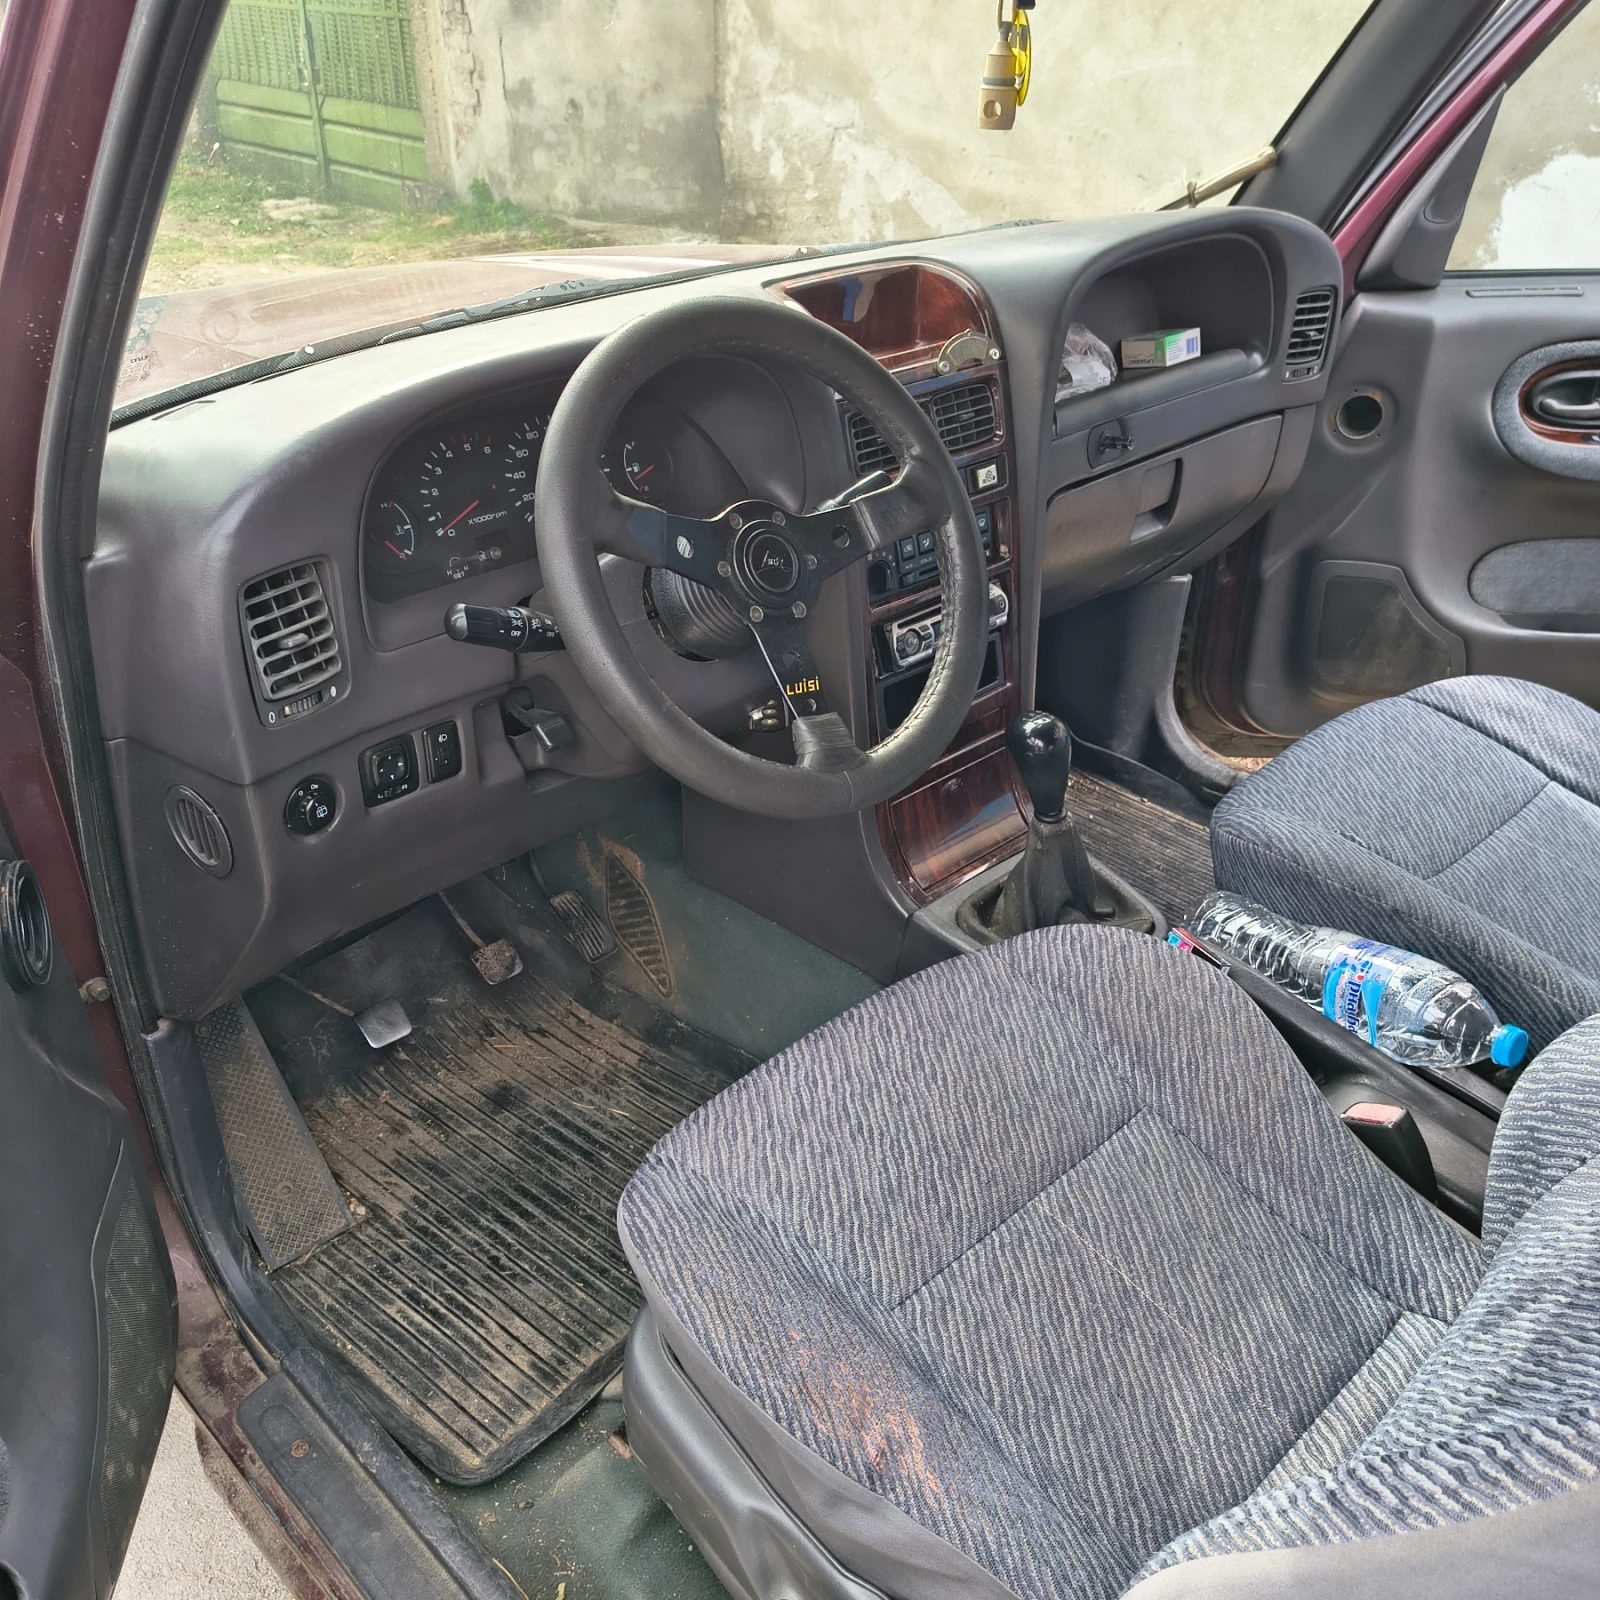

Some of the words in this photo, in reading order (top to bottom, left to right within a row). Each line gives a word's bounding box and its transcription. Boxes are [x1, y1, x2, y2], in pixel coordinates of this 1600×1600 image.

[525, 431, 539, 440] 80
[463, 443, 472, 451] 5
[483, 446, 491, 454] 6
[445, 450, 453, 458] 4
[515, 449, 529, 458] 60
[434, 467, 442, 475] 3
[513, 471, 526, 479] 40
[431, 488, 439, 496] 2
[522, 492, 535, 502] 20
[437, 511, 442, 519] 1
[447, 528, 456, 537] 0
[510, 630, 521, 638] OFF
